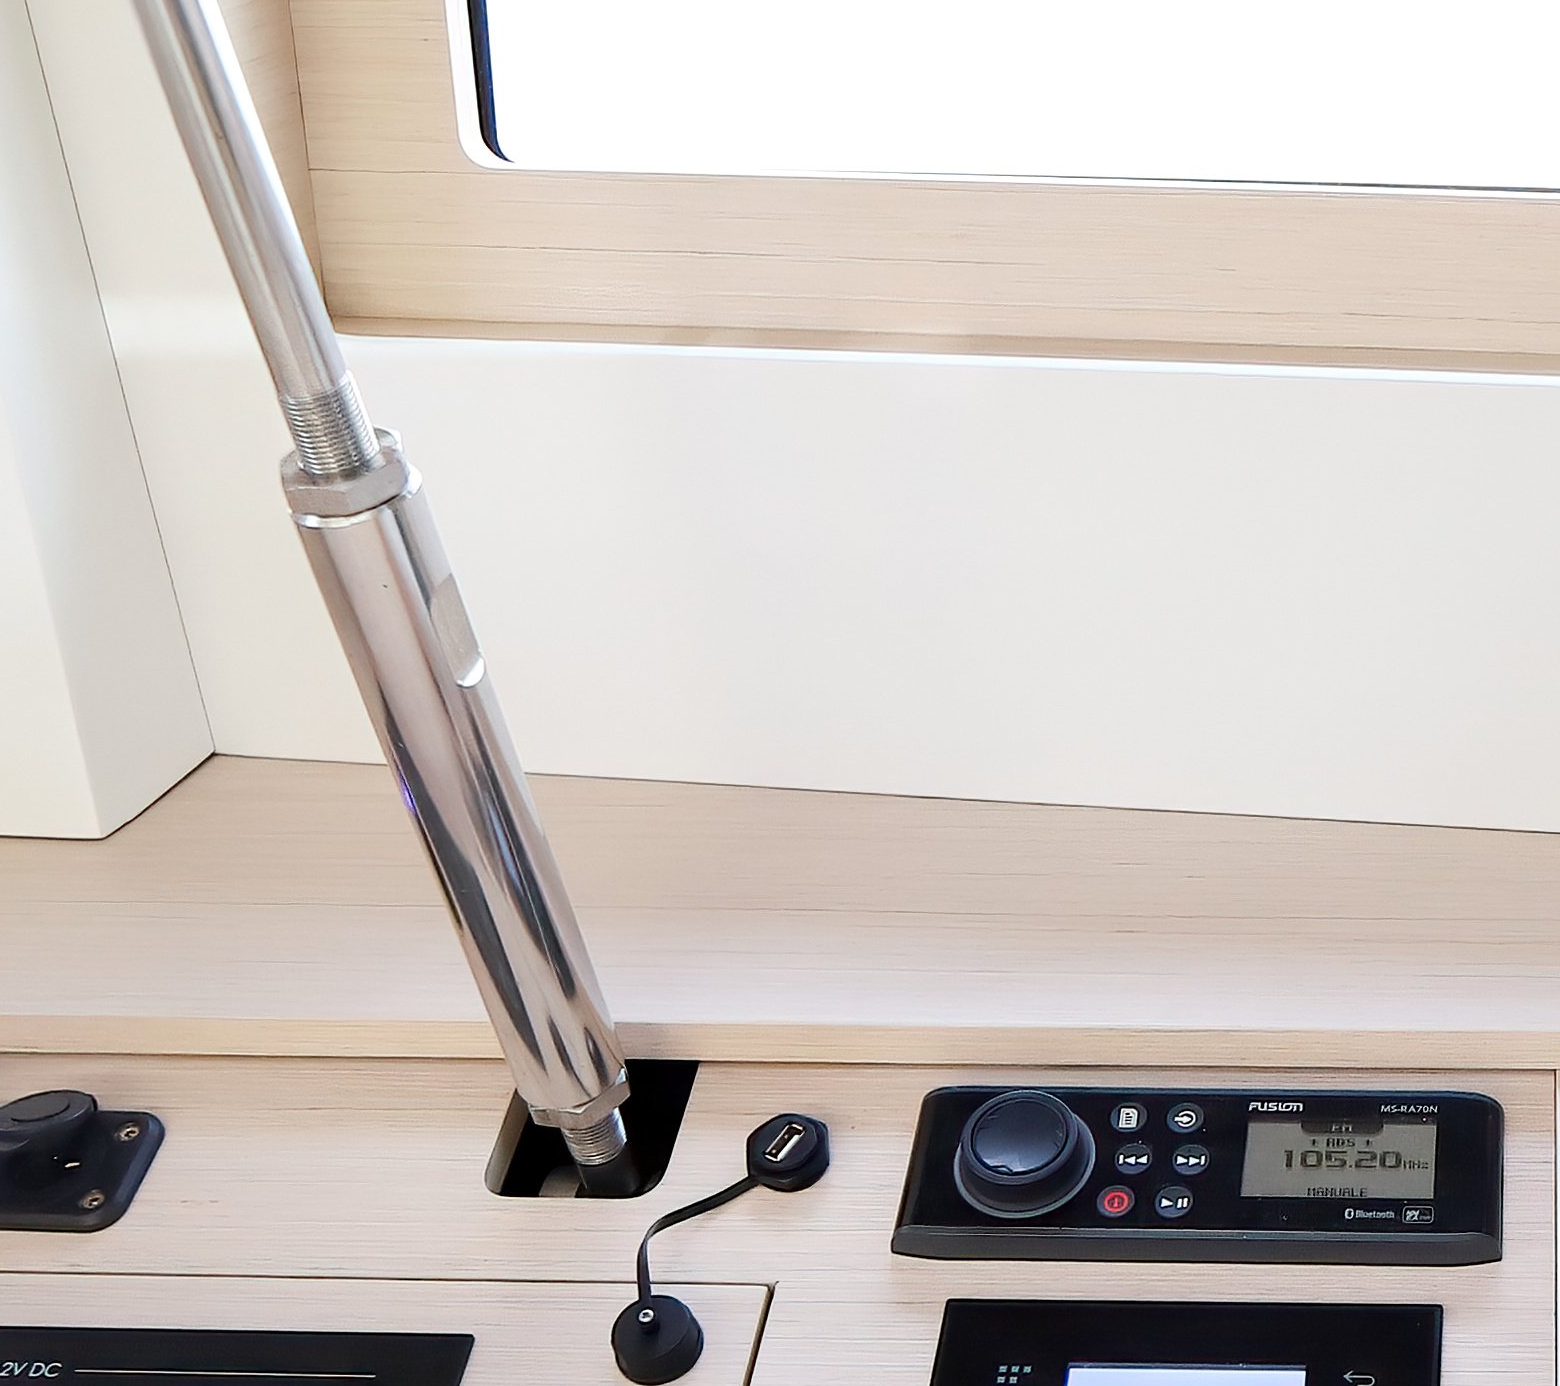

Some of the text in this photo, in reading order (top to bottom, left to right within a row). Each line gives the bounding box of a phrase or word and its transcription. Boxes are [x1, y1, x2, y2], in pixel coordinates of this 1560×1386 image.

[1380, 1104, 1438, 1114] MS-RA70N
[1284, 1150, 1402, 1169] 105.20
[1306, 1187, 1368, 1198] MANUALE
[28, 1362, 63, 1378] DC
